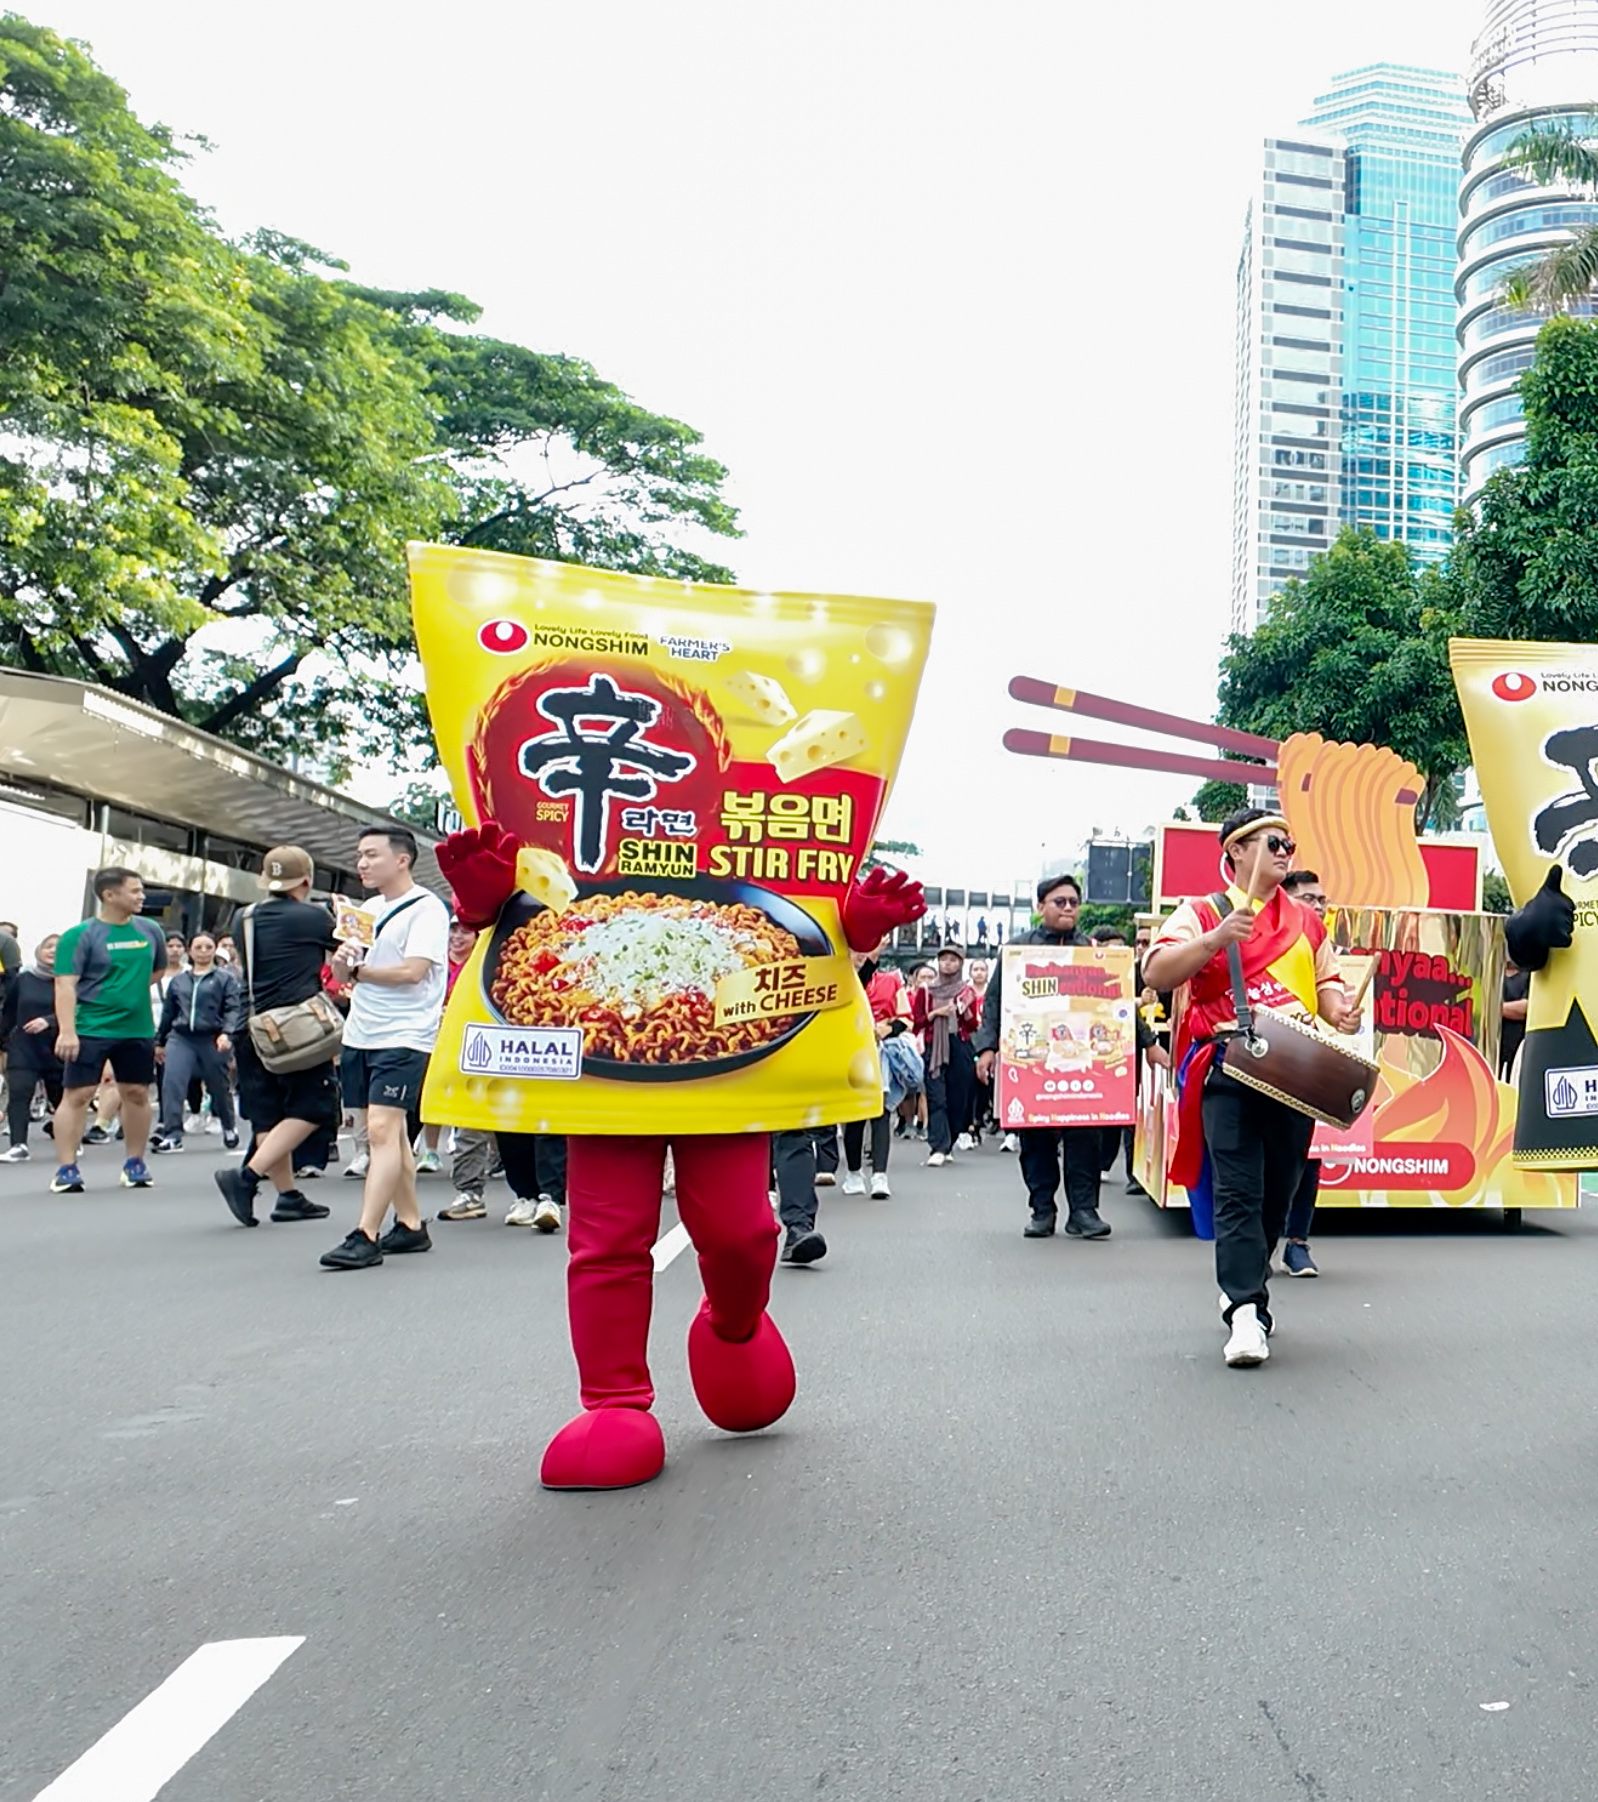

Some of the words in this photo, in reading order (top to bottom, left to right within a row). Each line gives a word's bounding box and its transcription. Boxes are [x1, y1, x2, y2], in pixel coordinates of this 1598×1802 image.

[534, 624, 566, 634] Lovely
[569, 627, 588, 635] Life
[590, 629, 621, 638] Lovely
[624, 632, 649, 640] Food
[534, 633, 649, 656] NONGSHIM
[660, 636, 730, 652] FARMER'S
[671, 647, 718, 661] HEART
[521, 675, 695, 872] 辛
[536, 810, 569, 822] SPICY
[623, 807, 696, 835] 라면
[720, 791, 852, 844] 볶음면
[621, 841, 695, 863] SHIN
[621, 861, 694, 876] RAMYUN
[709, 845, 788, 879] STIR
[797, 849, 854, 884] FRY
[754, 964, 806, 992] 치즈
[723, 1001, 756, 1017] with
[760, 984, 838, 1011] CHEESE
[501, 1040, 573, 1056] HALAL
[500, 1056, 572, 1065] INDONESIA
[1354, 1158, 1449, 1175] NONGSHIM
